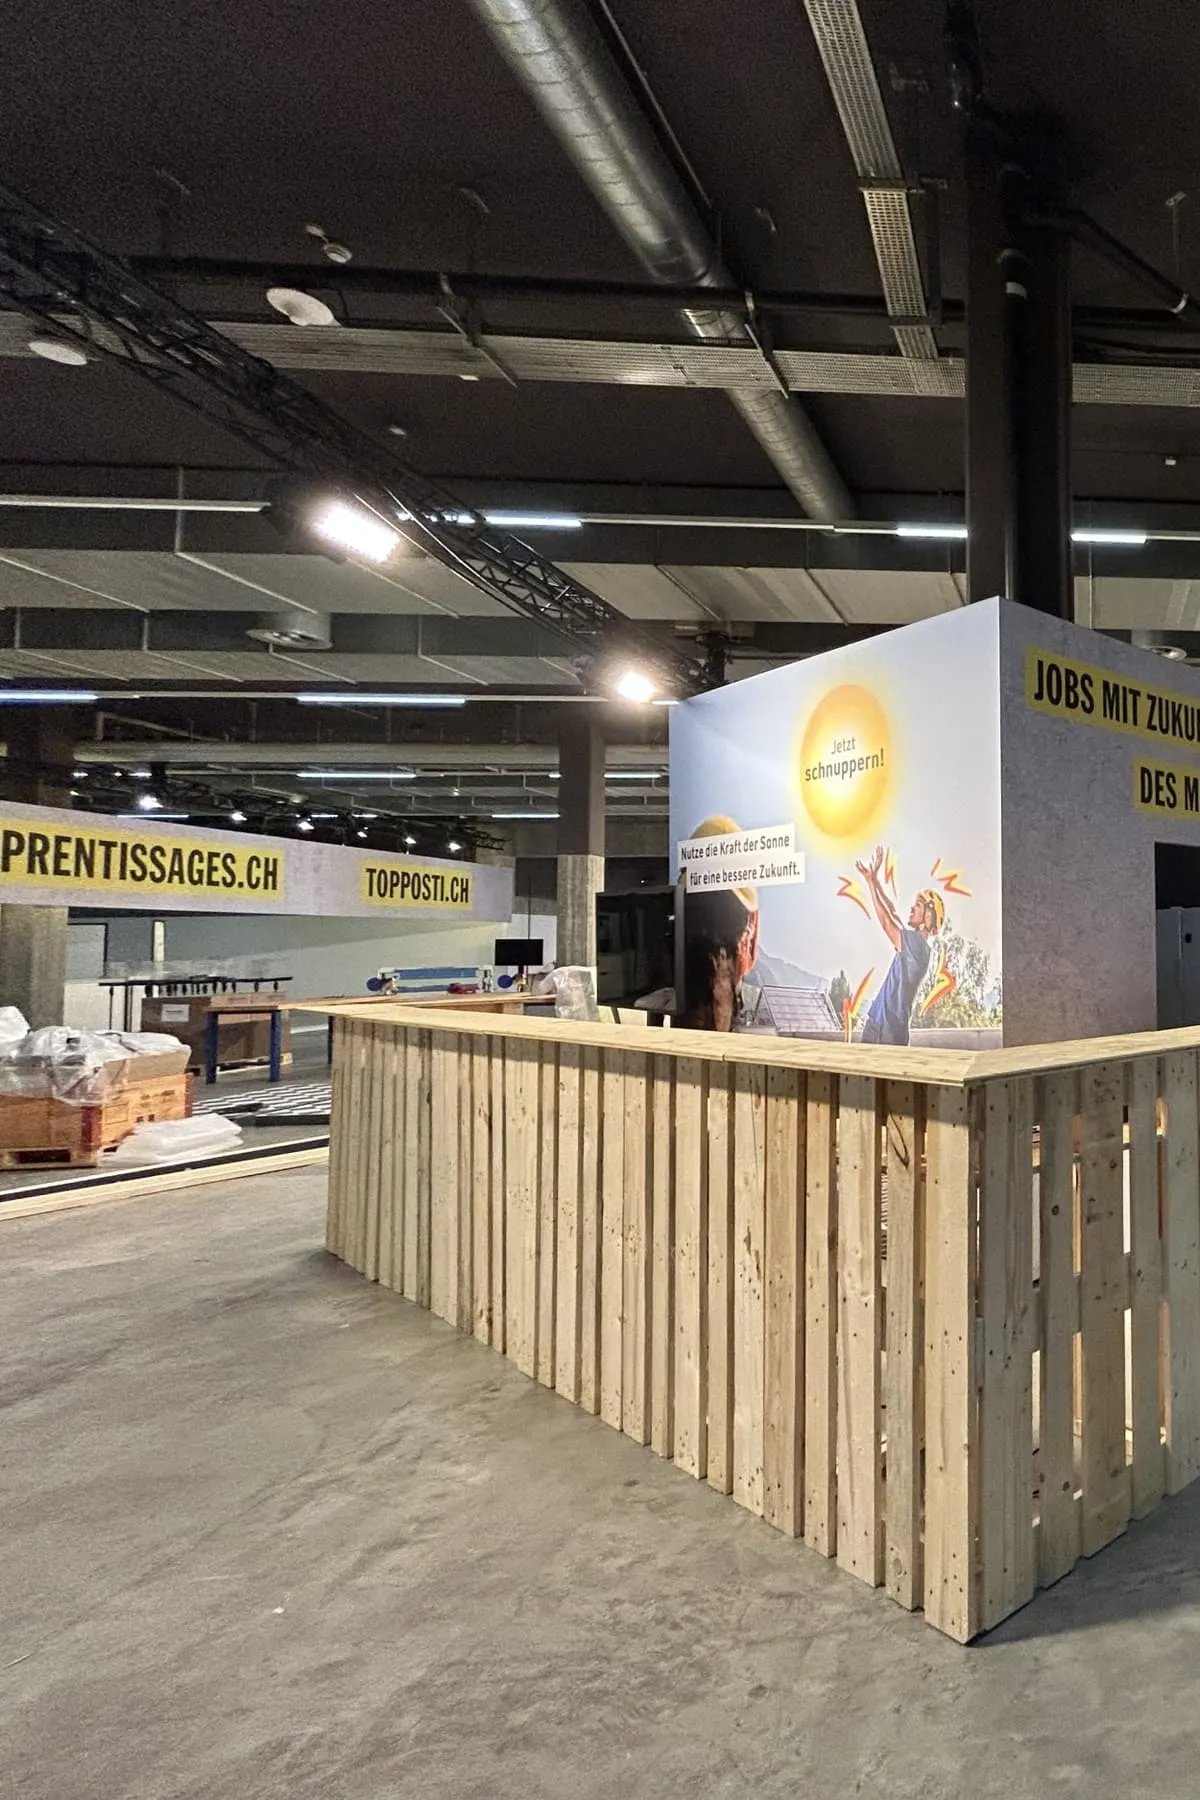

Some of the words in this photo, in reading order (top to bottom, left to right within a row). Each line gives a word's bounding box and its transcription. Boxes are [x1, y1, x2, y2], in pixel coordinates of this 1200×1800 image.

[1034, 659, 1094, 714] JOBS
[1102, 679, 1141, 727] MIT
[831, 736, 856, 755] Jetzt
[805, 747, 885, 781] schnuppern!
[1140, 766, 1176, 809] DES
[1, 829, 278, 891] PRENTISSAGES.CH
[681, 846, 704, 861] Nutze
[705, 843, 718, 857] die
[719, 840, 742, 856] Kraft
[743, 837, 758, 852] der
[760, 834, 790, 850] Sonne
[365, 868, 469, 903] TOPPOSTI.CH
[689, 872, 702, 886] für
[703, 870, 721, 885] eine
[722, 866, 758, 882] bessere
[759, 861, 800, 879] Zukunft.
